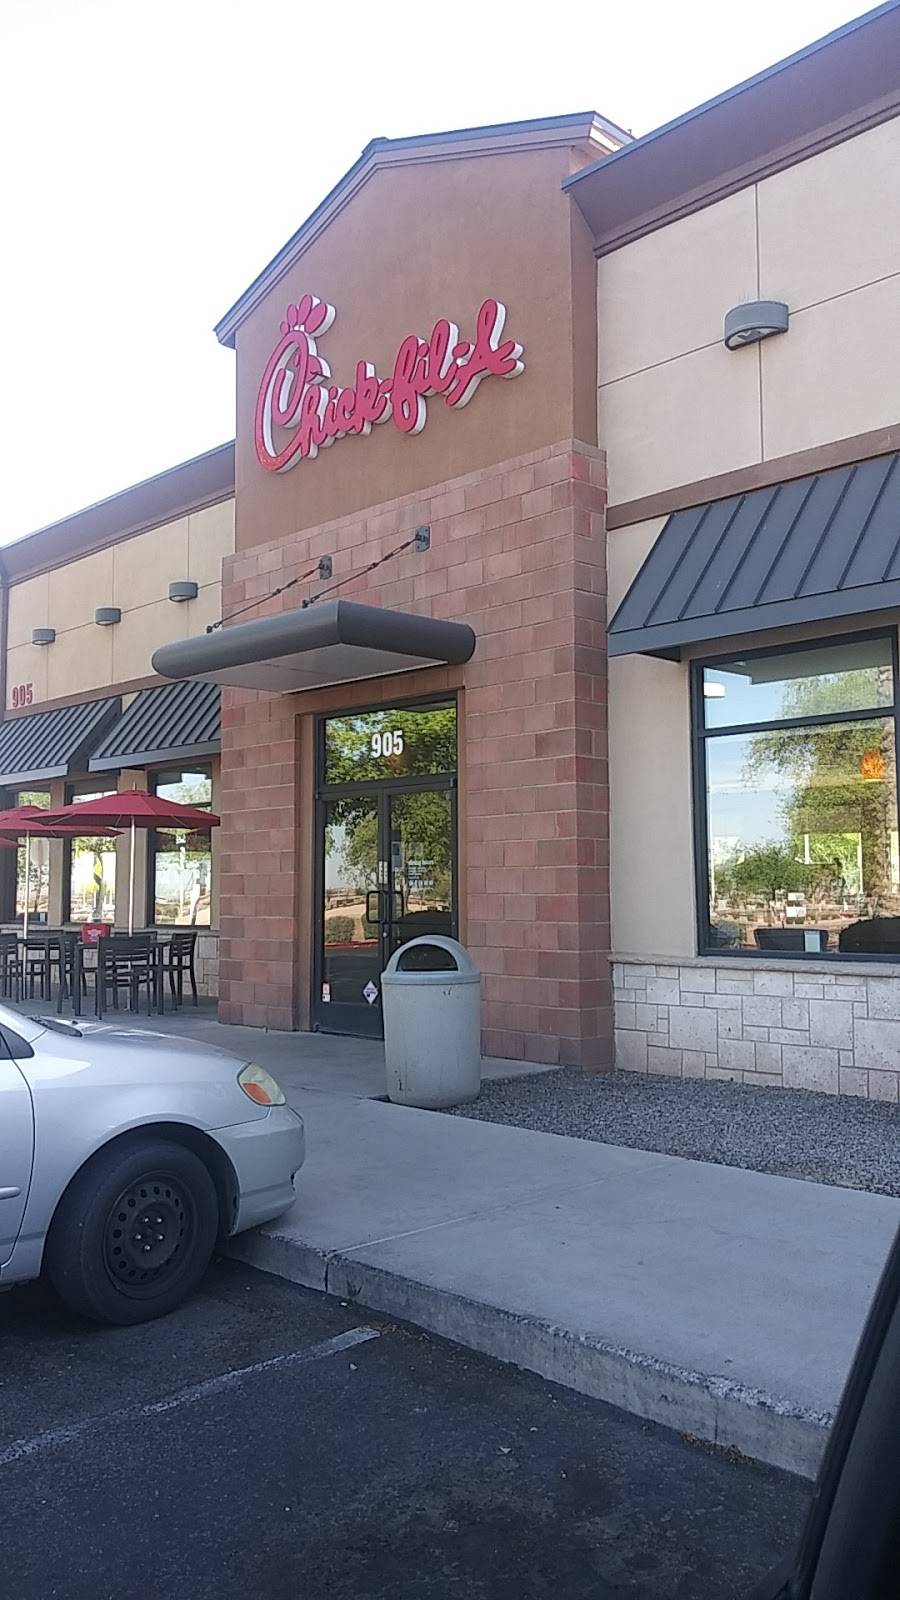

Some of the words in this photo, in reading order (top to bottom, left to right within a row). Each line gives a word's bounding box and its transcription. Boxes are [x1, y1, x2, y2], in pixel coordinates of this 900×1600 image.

[254, 295, 525, 474] Chick-fil-A
[12, 682, 33, 708] 905
[369, 729, 404, 758] 905
